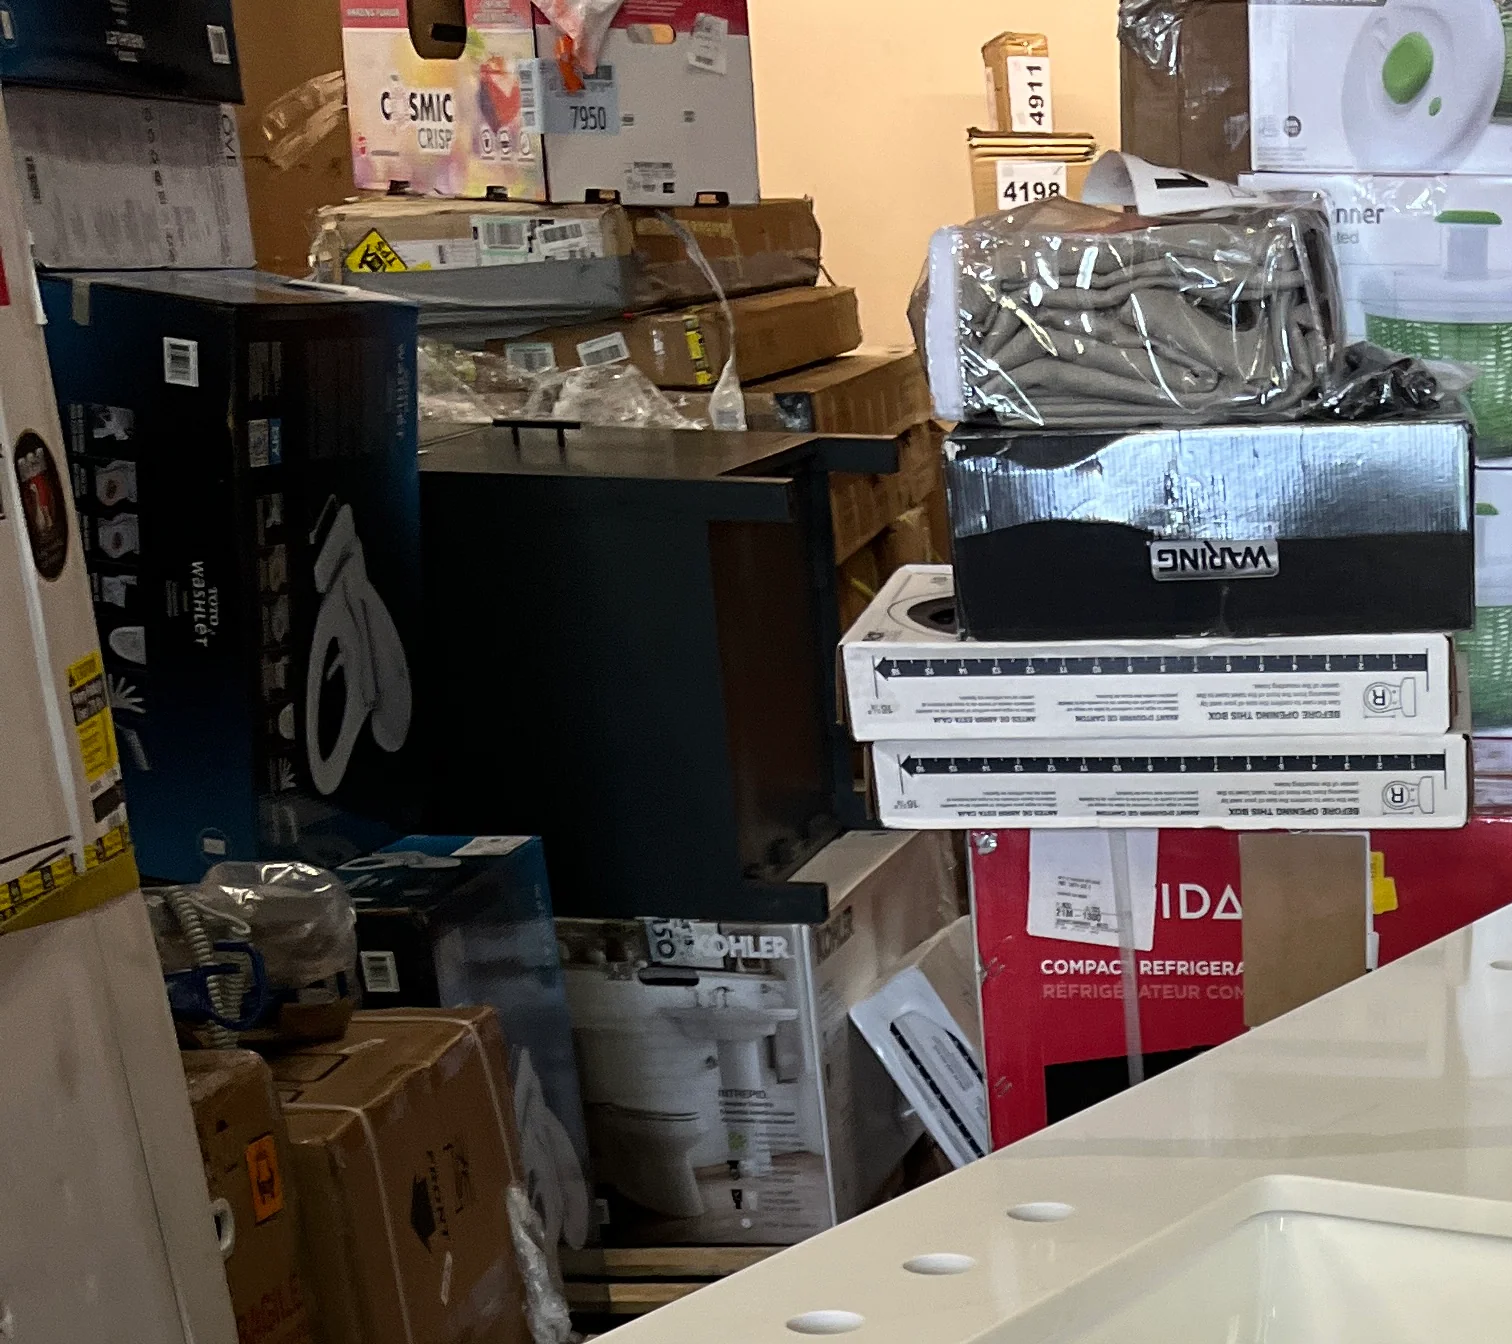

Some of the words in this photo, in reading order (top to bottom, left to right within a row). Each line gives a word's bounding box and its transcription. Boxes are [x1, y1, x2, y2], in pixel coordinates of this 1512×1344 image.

[1026, 64, 1044, 125] 4911
[570, 106, 606, 130] 7950
[1003, 181, 1060, 202] 4198
[1334, 206, 1384, 225] nner
[1157, 541, 1271, 571] WARING
[1373, 689, 1385, 706] R
[1391, 787, 1404, 804] R
[1041, 960, 1123, 975] COMPAC
[1043, 981, 1200, 1000] RÉFRIGÉATEUR
